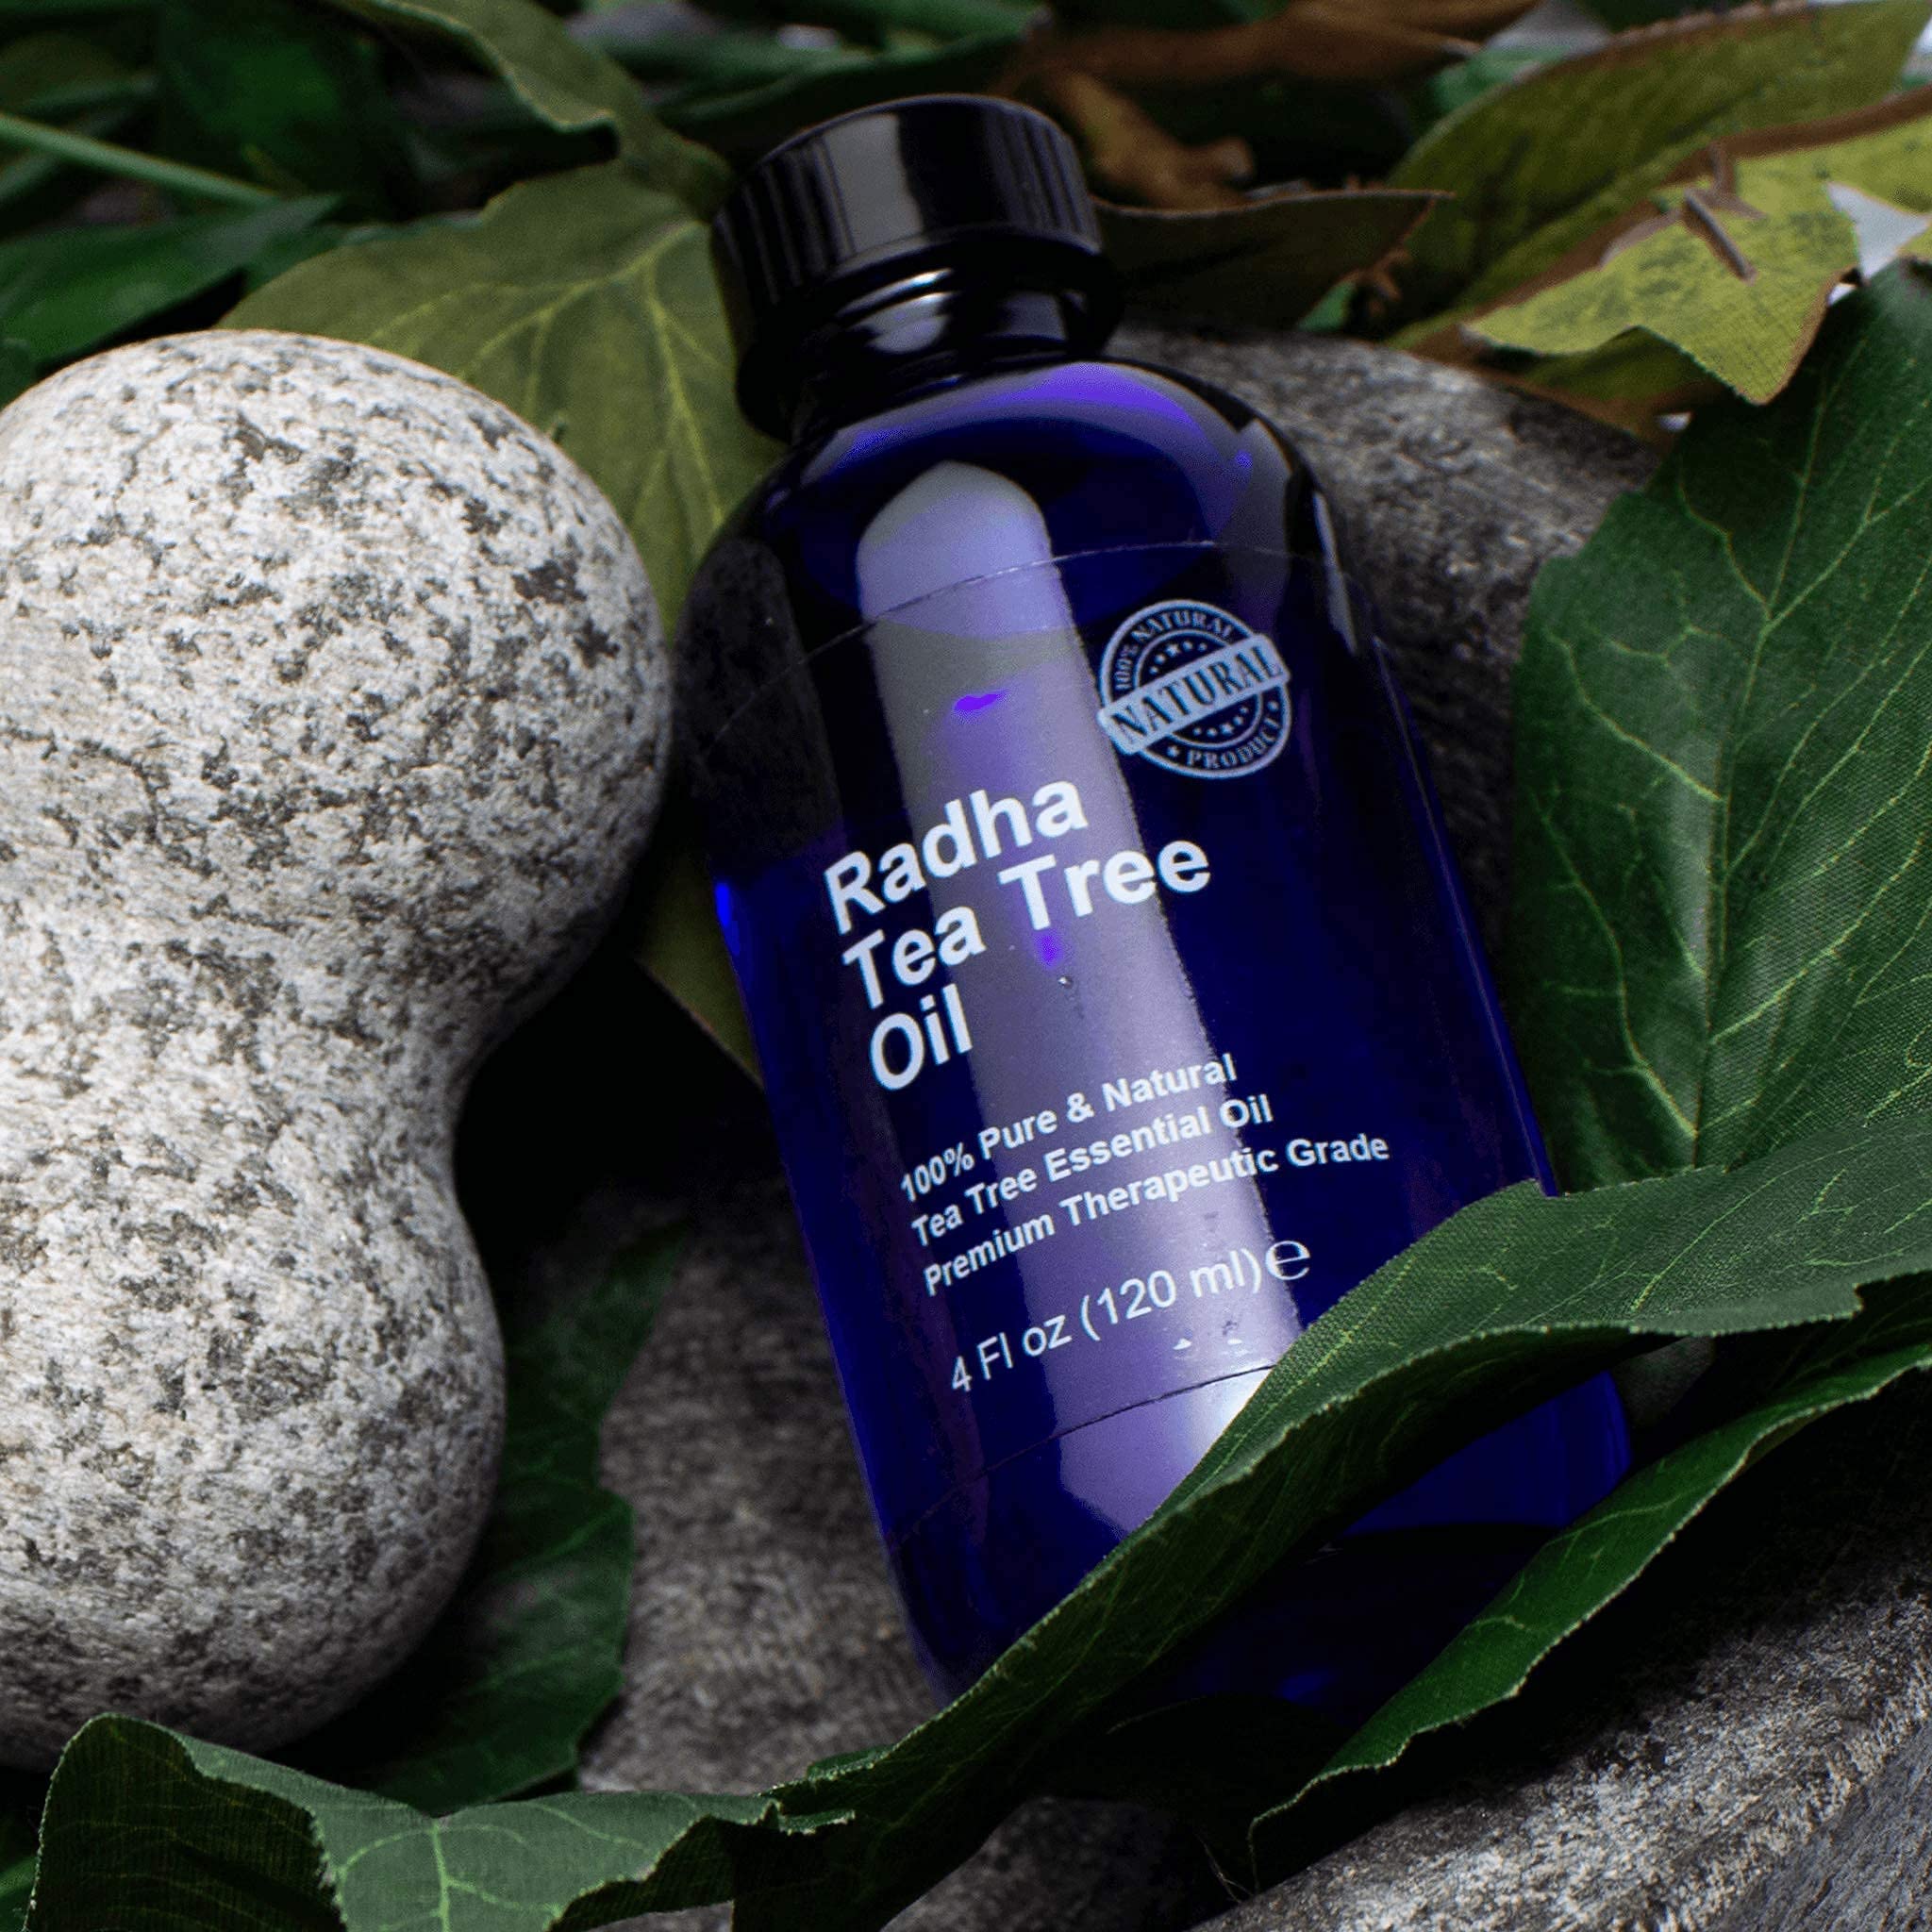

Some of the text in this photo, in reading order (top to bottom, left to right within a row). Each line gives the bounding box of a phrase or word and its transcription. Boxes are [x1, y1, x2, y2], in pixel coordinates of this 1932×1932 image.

[1111, 645, 1284, 746] NATURAL
[824, 780, 1089, 935] Radha
[841, 840, 1211, 1009] Tea Tree
[870, 983, 973, 1091] Oil
[900, 1054, 1239, 1203] 100% Pure & Natural
[910, 1094, 1274, 1247] Tea Tree Essential Oil
[922, 1133, 1390, 1296] Premium Therapeutic Grade
[950, 1357, 971, 1392] 4
[977, 1332, 1013, 1379] Fl
[1022, 1314, 1074, 1357] oz
[1079, 1270, 1176, 1341] (120
